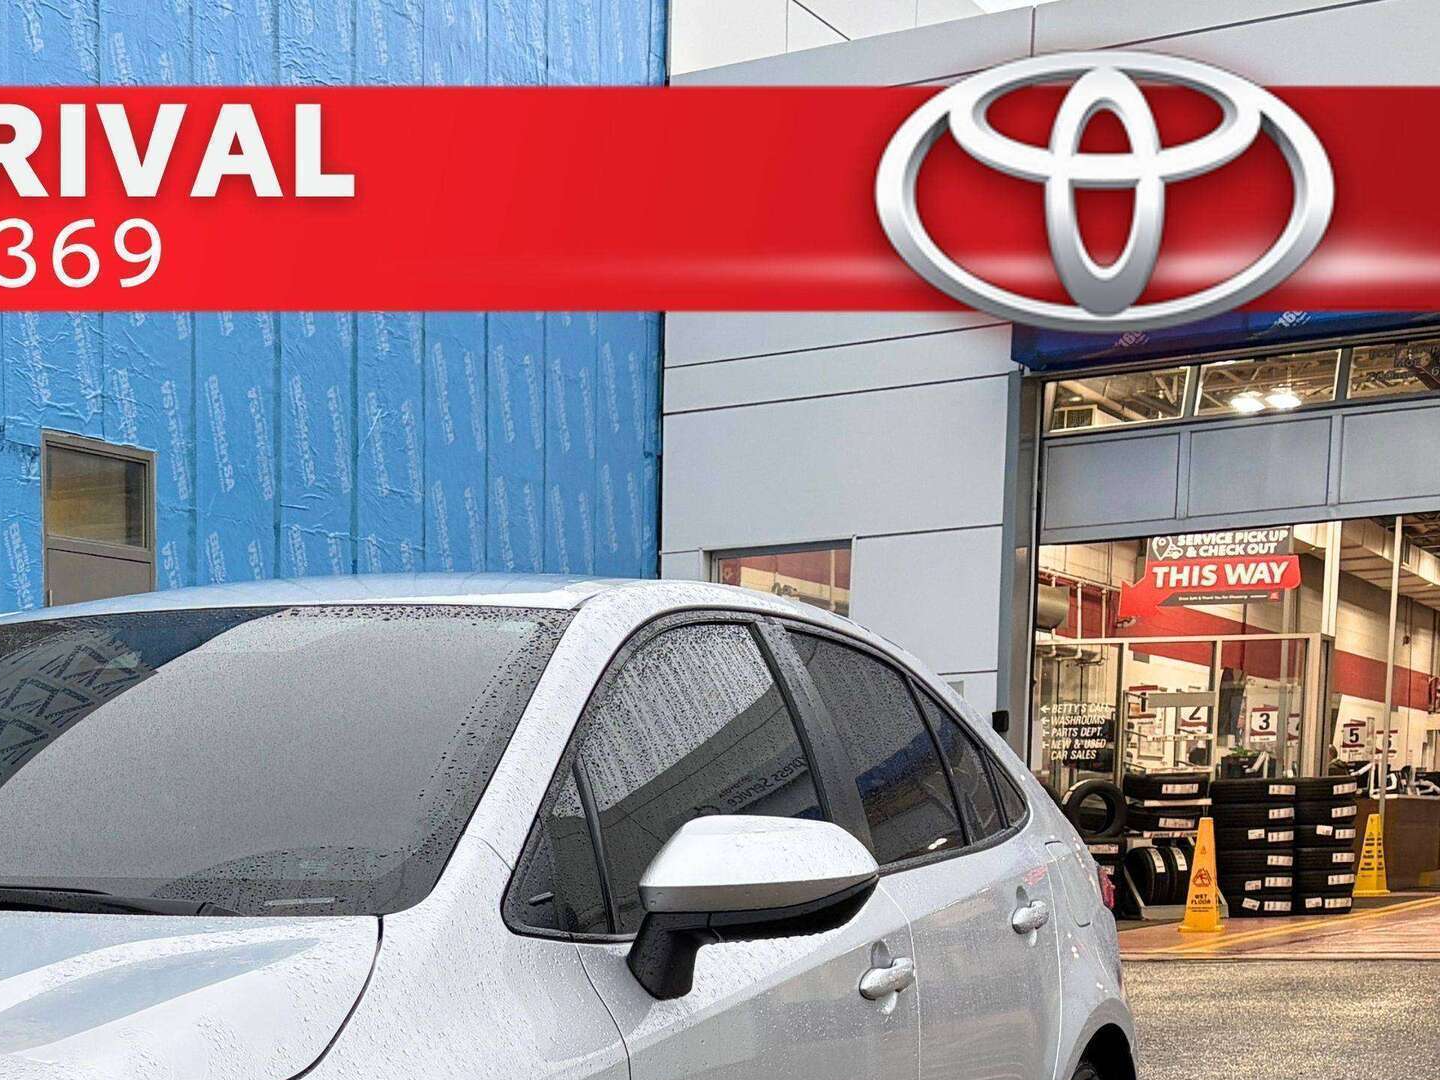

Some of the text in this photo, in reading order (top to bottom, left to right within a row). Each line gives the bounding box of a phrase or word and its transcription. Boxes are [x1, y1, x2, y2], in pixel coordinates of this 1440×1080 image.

[1176, 529, 1289, 547] SERVICE PICK UP
[1185, 541, 1278, 557] & CHECK OUT
[1151, 561, 1289, 588] THIS WAY
[1051, 703, 1088, 714] BETTY'S
[1050, 714, 1106, 726] WASHROOMS
[1258, 712, 1271, 731] 3
[1050, 726, 1104, 737] PARTS DEPT.
[1348, 727, 1360, 743] 5
[1050, 738, 1107, 750] NEW & USED
[1050, 749, 1097, 761] CAR SALES
